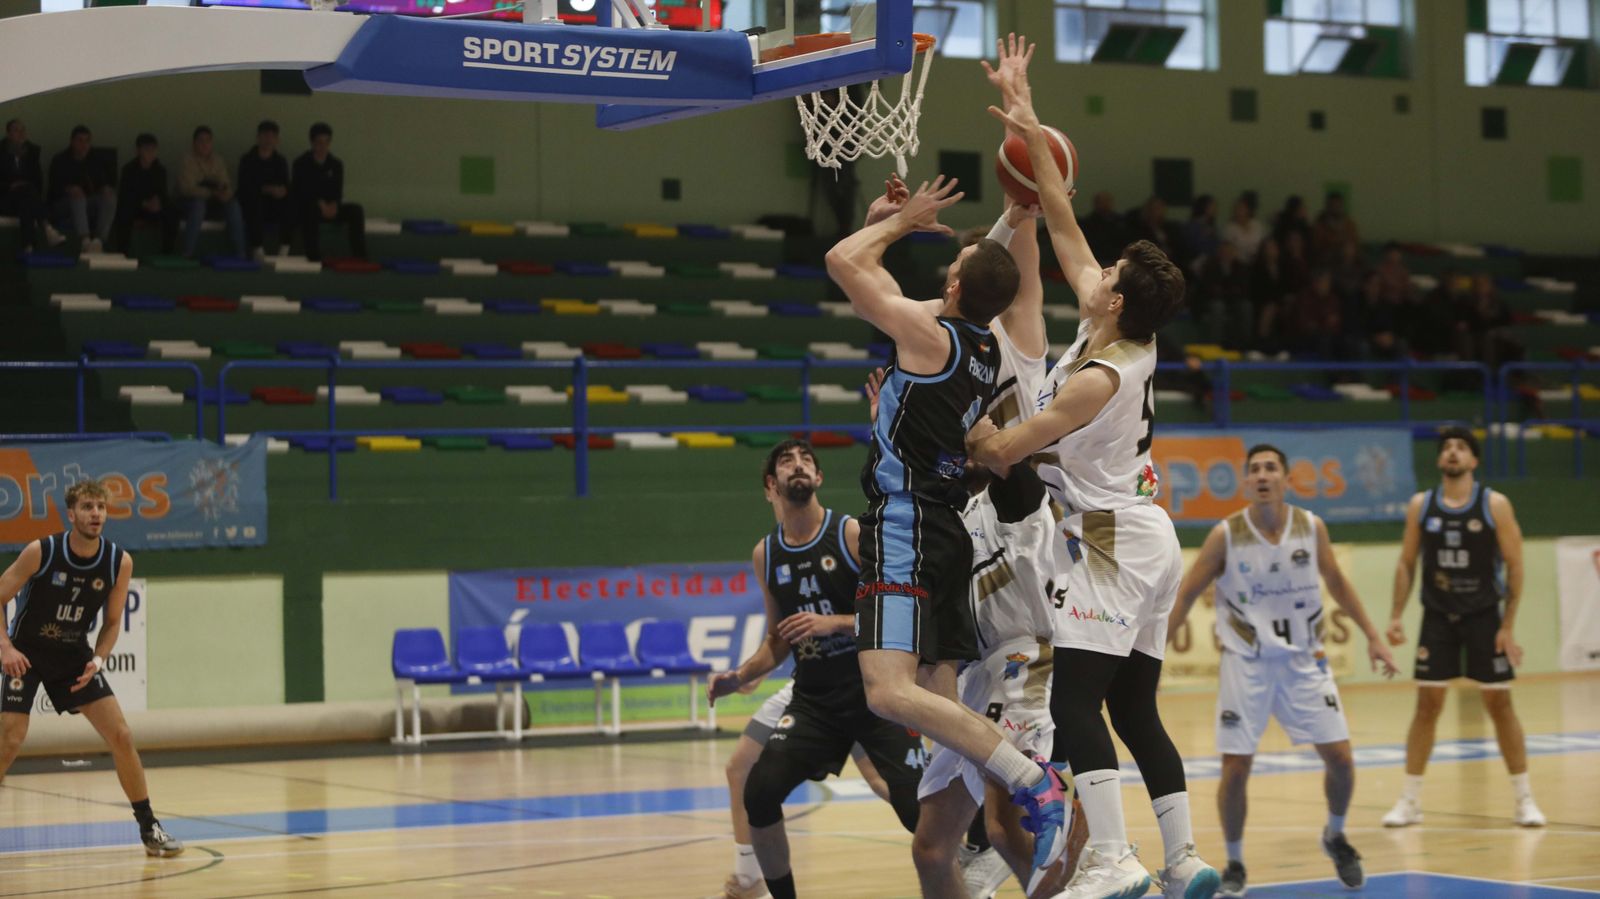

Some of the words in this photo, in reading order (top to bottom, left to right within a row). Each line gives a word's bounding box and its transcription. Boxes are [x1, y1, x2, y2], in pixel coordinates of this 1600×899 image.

[463, 37, 559, 65] SPORT
[561, 44, 677, 75] SYSTEM
[72, 587, 81, 602] 7
[516, 571, 748, 601] Electricidad
[799, 574, 820, 598] 44
[56, 604, 85, 622] ULB
[1272, 618, 1292, 645] 4
[101, 653, 136, 673] om
[1324, 694, 1339, 712] 4
